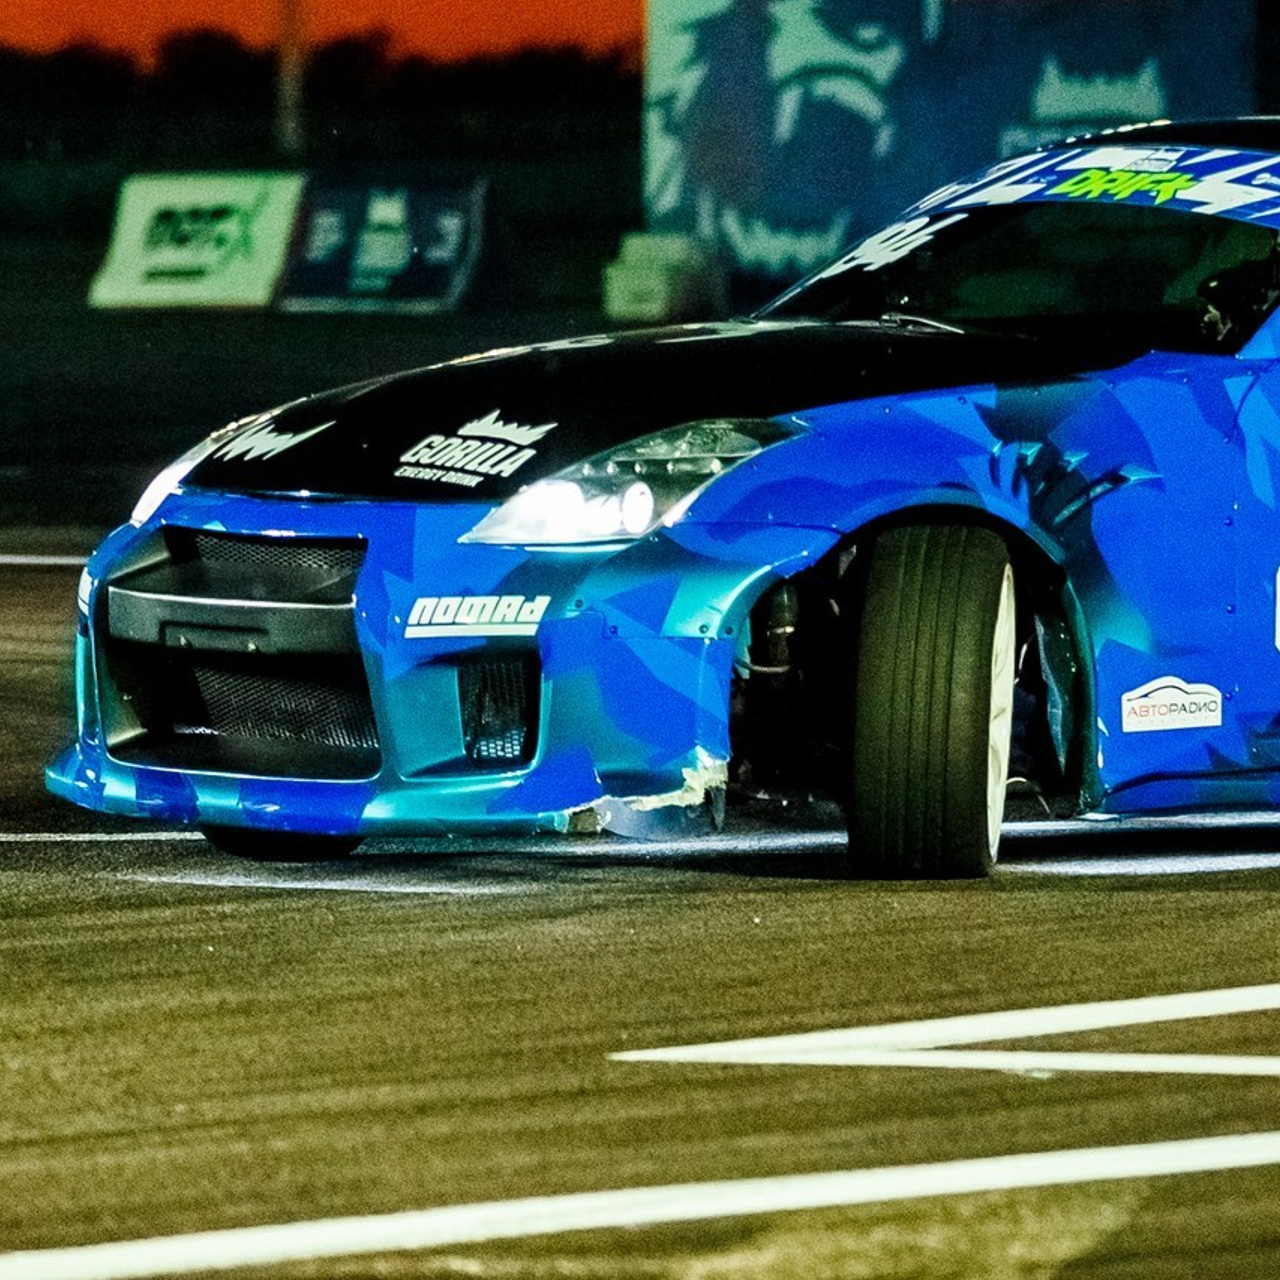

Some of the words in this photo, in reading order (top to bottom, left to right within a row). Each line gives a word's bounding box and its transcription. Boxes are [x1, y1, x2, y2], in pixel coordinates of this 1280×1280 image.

[1044, 168, 1201, 205] DRIFT
[399, 434, 537, 478] GORILLA
[393, 465, 444, 482] ENERGY
[440, 471, 484, 488] DRINK
[1126, 699, 1219, 718] АВТОРАДИО
